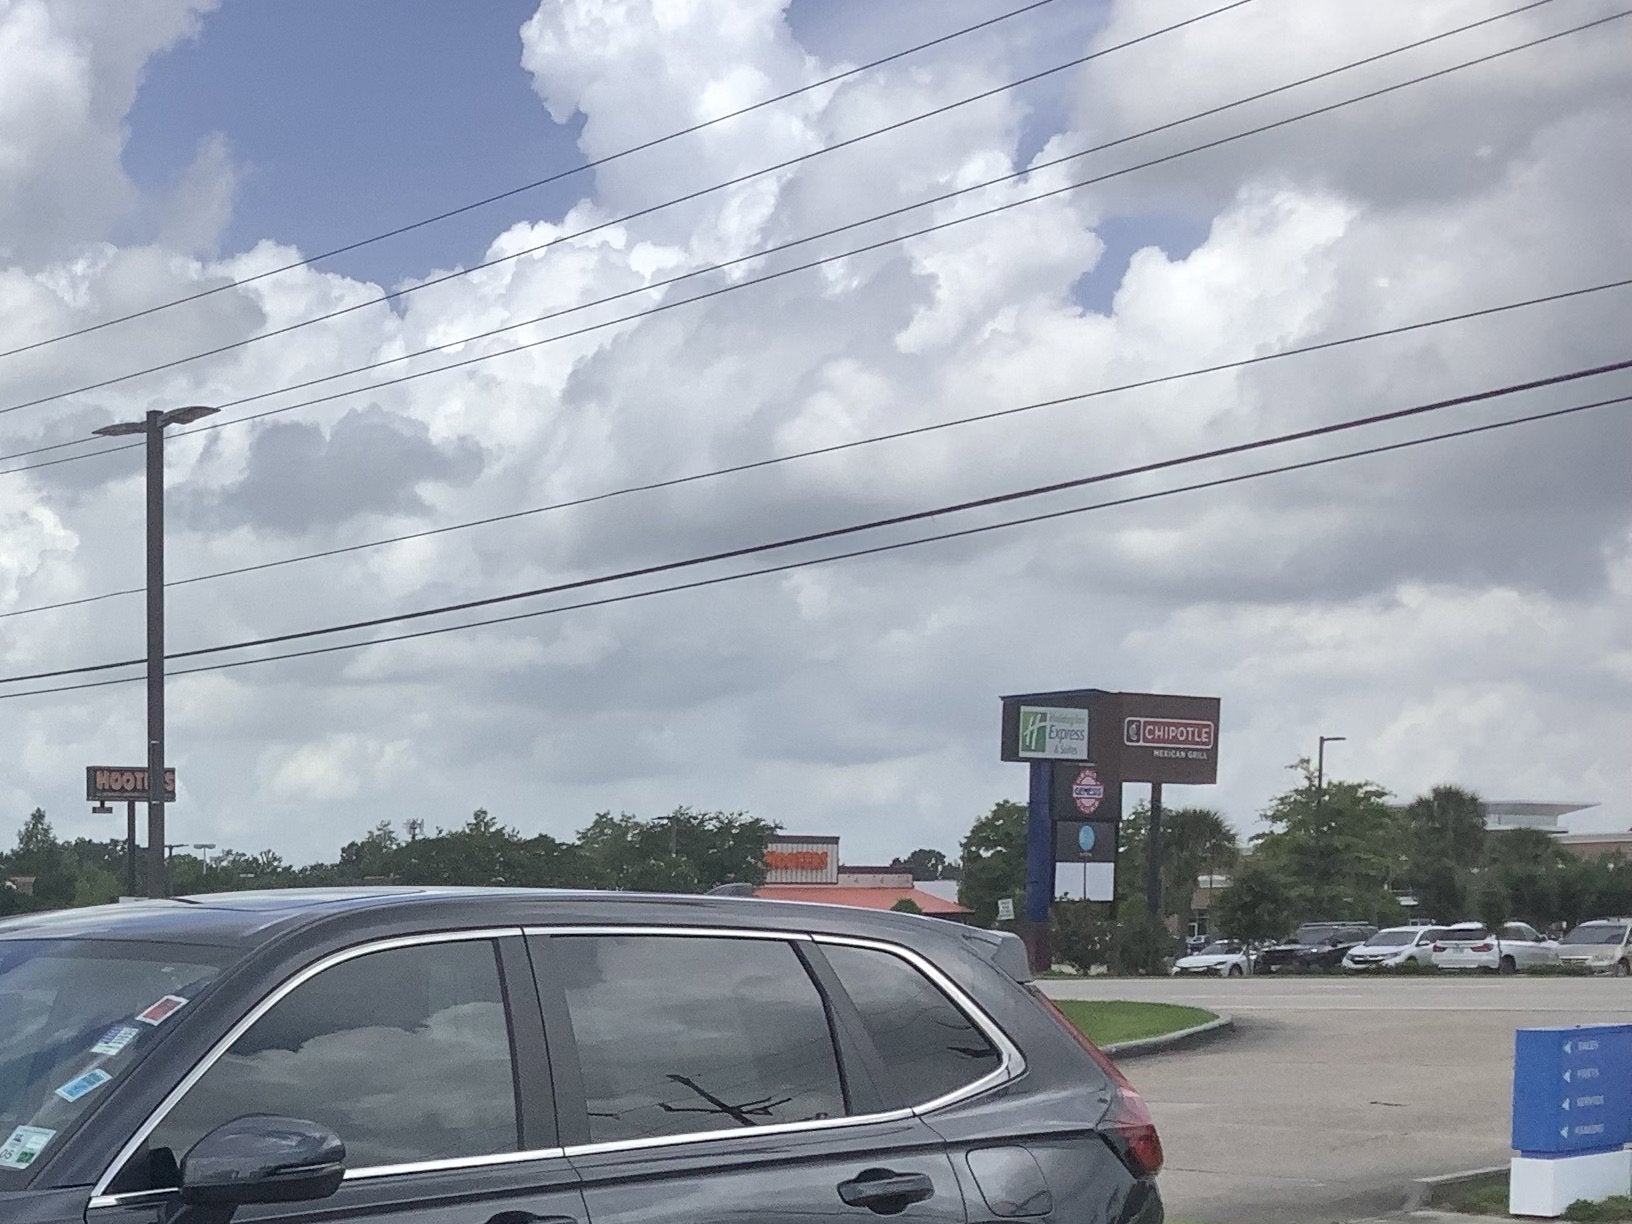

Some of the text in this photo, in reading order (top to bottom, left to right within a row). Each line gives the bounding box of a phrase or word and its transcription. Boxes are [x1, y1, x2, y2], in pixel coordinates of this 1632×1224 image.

[1048, 724, 1085, 743] Express
[1145, 725, 1210, 743] CHIPOTLE
[1153, 750, 1207, 760] MEXICAN GRILL
[96, 770, 174, 792] HOOTS
